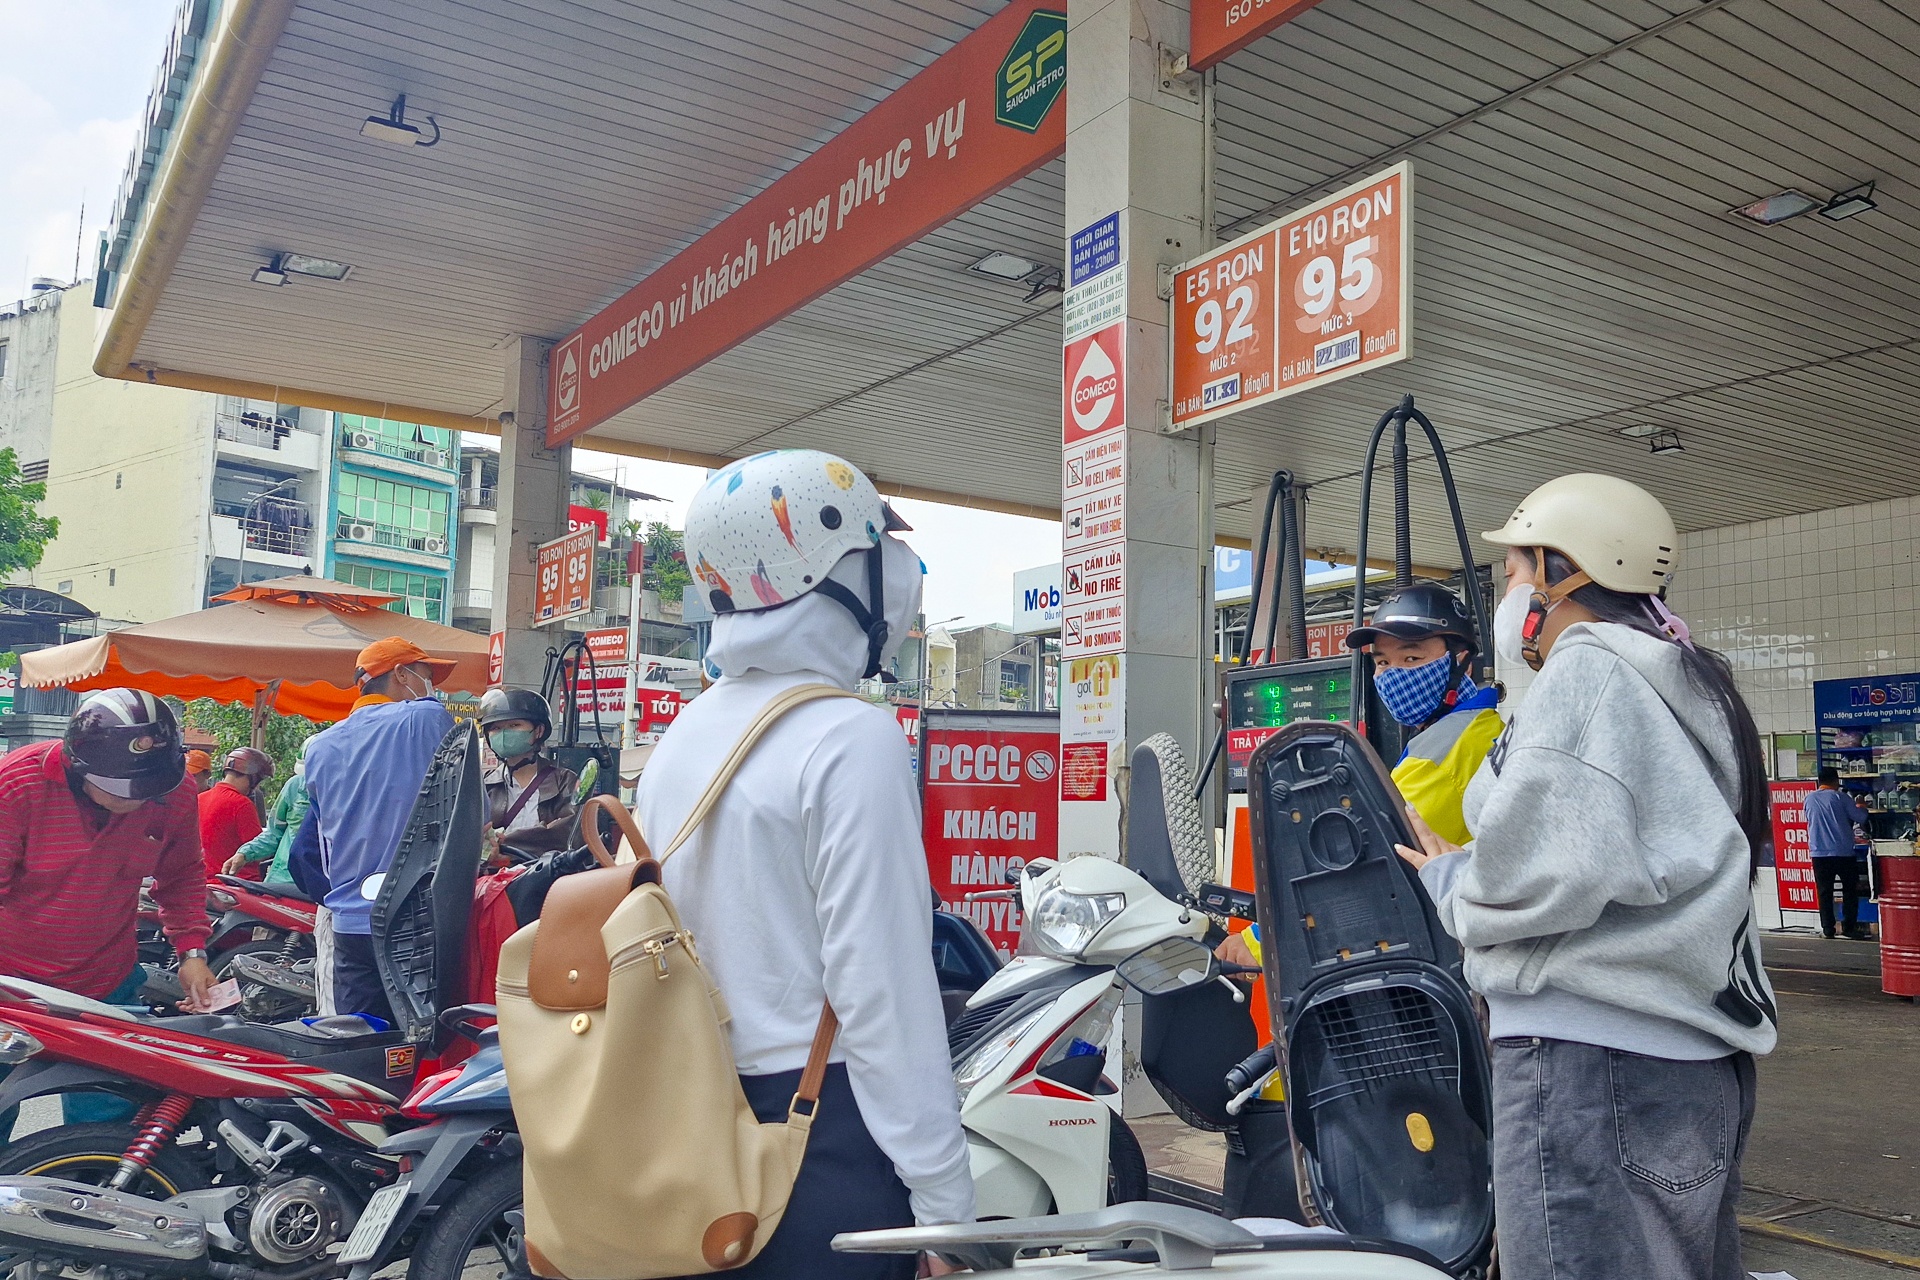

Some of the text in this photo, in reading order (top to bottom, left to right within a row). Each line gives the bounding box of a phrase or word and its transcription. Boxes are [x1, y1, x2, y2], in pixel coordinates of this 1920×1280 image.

[1005, 29, 1065, 99] SP
[1006, 65, 1065, 113] SAIGON PETRO
[1289, 184, 1393, 257] E10 RON
[589, 98, 966, 380] COMECO vì khách hàng phục vụ
[1074, 220, 1114, 250] THỜI GIAN
[1074, 235, 1115, 265] BÁN HÀNG
[1074, 262, 1090, 280] 0h00
[1095, 250, 1115, 270] 23h00
[1186, 244, 1264, 304] E5 RON
[1302, 235, 1375, 316] 95
[1194, 285, 1254, 355] 92
[1320, 312, 1353, 336] MỨC 3
[1210, 352, 1236, 373] MỨC 2
[1282, 360, 1295, 382] GIÁ
[1296, 356, 1314, 378] BÁN:
[560, 374, 576, 392] COMECO
[1076, 377, 1117, 403] COMECO
[1176, 395, 1188, 417] GIÁ
[1085, 464, 1122, 488] NO CELL PHONE
[1098, 493, 1112, 512] MÁY
[1114, 494, 1122, 507] XE
[550, 544, 564, 562] RON
[566, 533, 592, 556] E10 RON
[568, 553, 588, 584] 95
[1084, 549, 1122, 572] CẤM LỬA
[542, 563, 559, 594] 95
[1084, 576, 1122, 597] NO FIRE
[1024, 585, 1062, 612] Mob
[588, 634, 624, 647] COMECO
[1084, 630, 1122, 648] NO SMOKING
[1308, 627, 1326, 640] RON
[1334, 625, 1344, 636] E5
[1076, 679, 1092, 698] got
[1850, 682, 1916, 707] Mobil
[650, 693, 676, 715] TỐT
[1823, 711, 1836, 720] Dầu
[1836, 711, 1853, 720] động
[1864, 708, 1879, 718] tổng
[1880, 709, 1894, 718] hợp
[1894, 708, 1911, 716] hàng
[1232, 732, 1252, 750] TRẢ
[928, 743, 1022, 782] PCCC
[1772, 787, 1795, 804] KHÁCH
[943, 806, 1037, 841] KHÁCH
[1780, 806, 1796, 824] QUÉT
[1784, 828, 1808, 843] QR
[1784, 844, 1796, 862] LẤY
[1779, 868, 1801, 882] THANH
[1788, 885, 1814, 904] TẠI ĐÂY
[1048, 1118, 1098, 1126] HONDA
